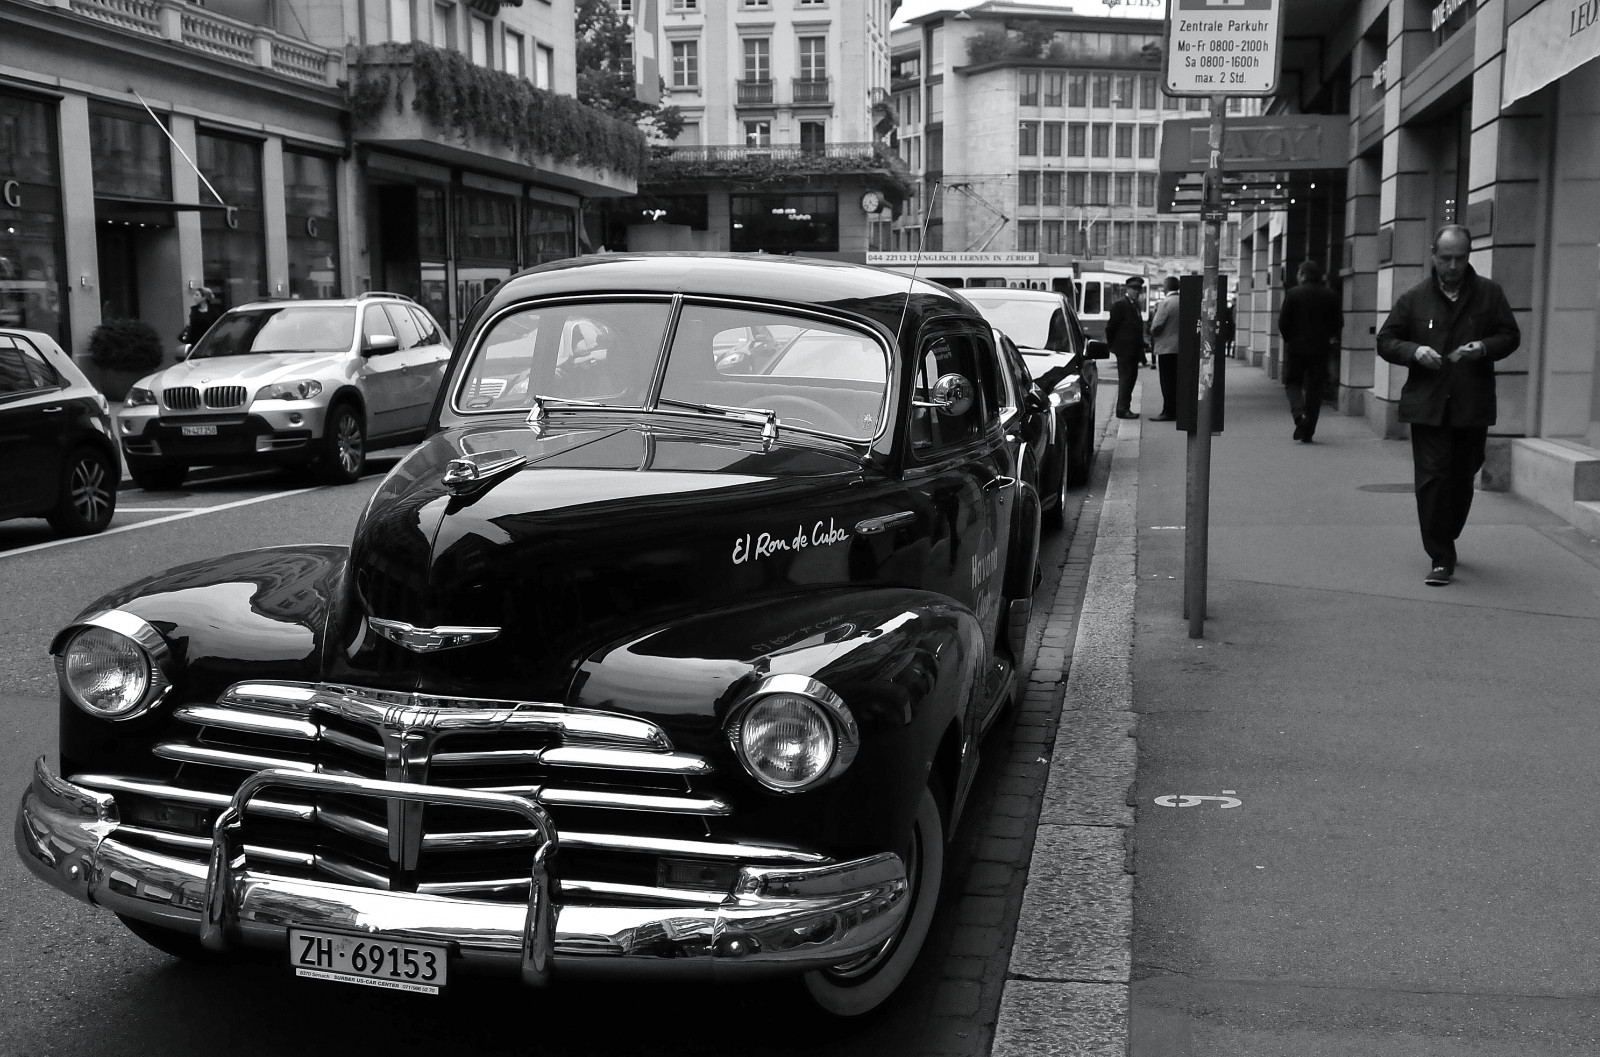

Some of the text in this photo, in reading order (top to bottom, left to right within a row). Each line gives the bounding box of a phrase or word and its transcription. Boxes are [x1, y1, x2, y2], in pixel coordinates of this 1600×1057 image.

[1179, 20, 1269, 32] Zentrale Parkuhr
[1569, 0, 1600, 38] LEO
[1185, 56, 1197, 68] Sa
[1195, 72, 1247, 83] max. 2 Std.
[3, 180, 21, 208] G
[306, 216, 318, 238] G
[732, 517, 850, 565] El Ron de Cuba
[351, 942, 437, 981] 69153
[356, 978, 377, 986] US-CAR
